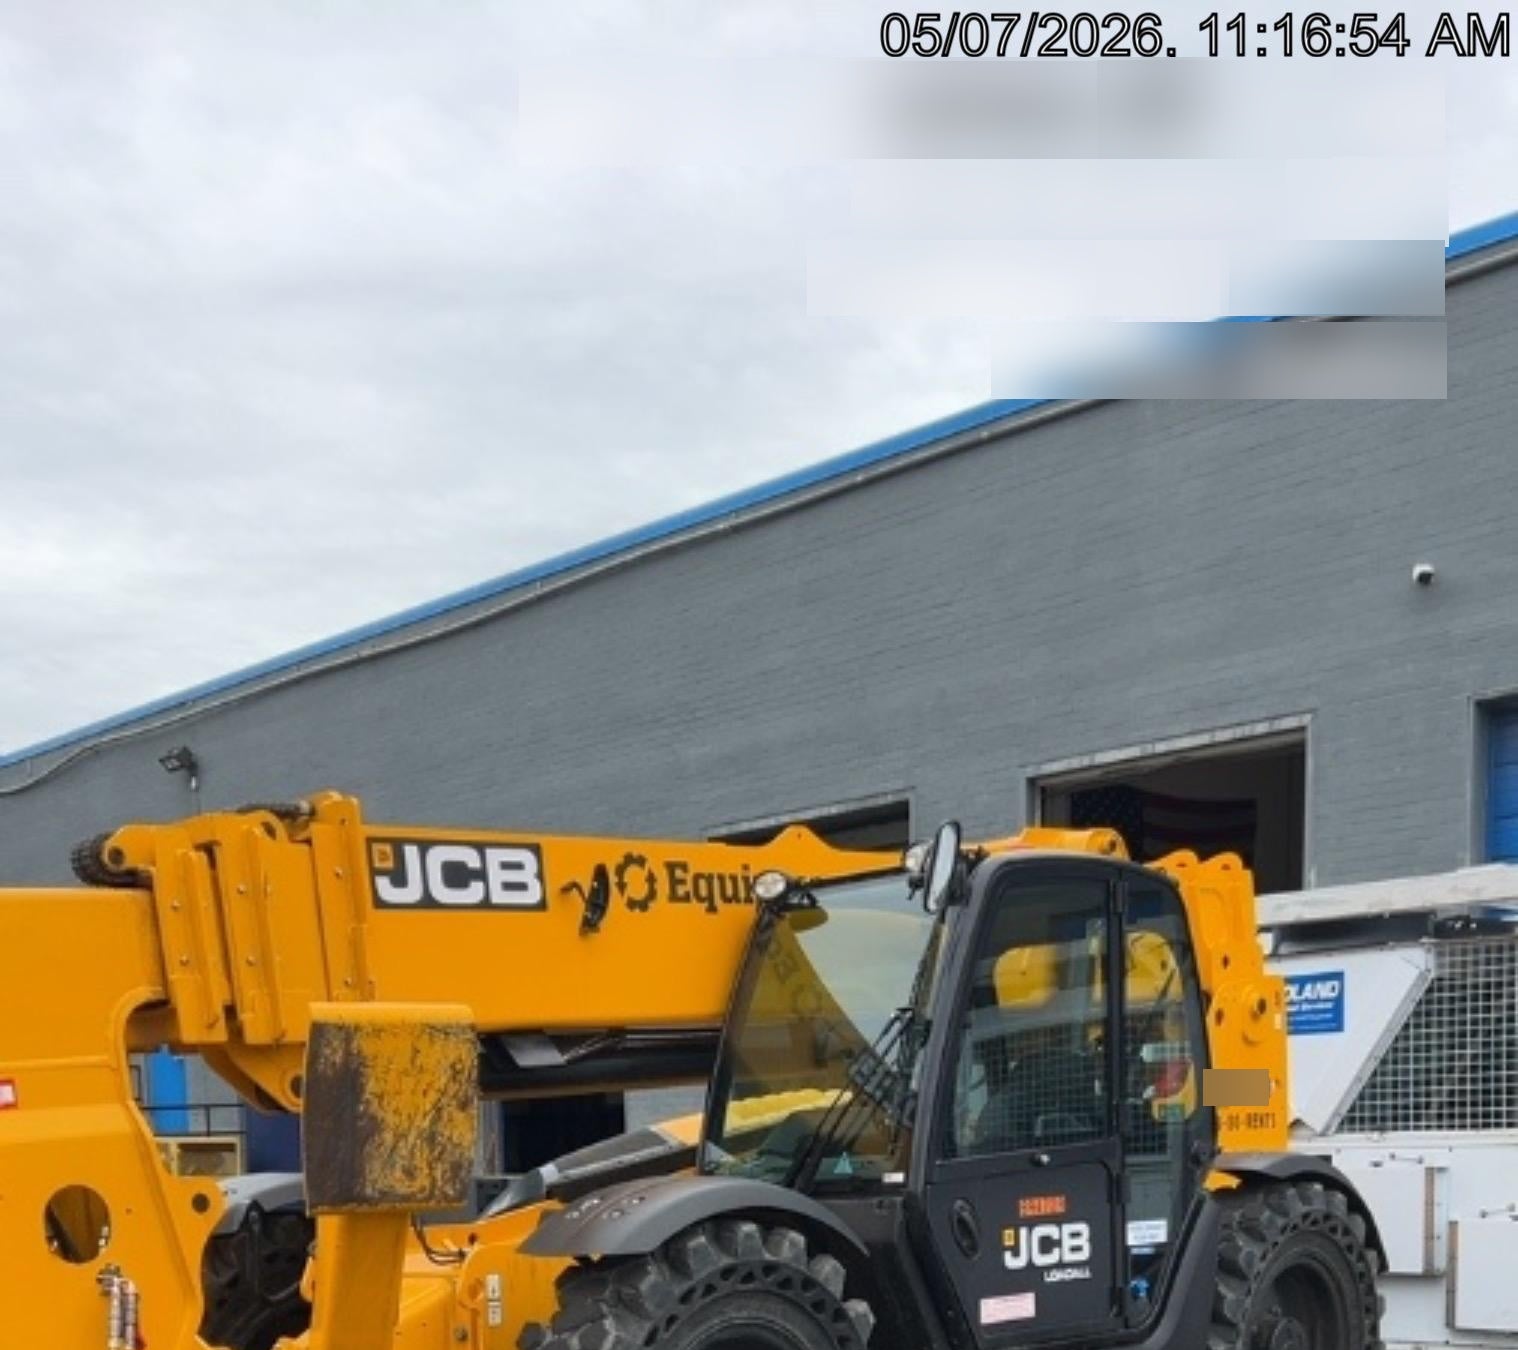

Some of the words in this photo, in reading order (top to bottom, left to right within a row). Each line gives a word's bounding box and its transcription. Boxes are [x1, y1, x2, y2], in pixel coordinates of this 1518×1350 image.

[373, 843, 543, 904] JCB
[664, 861, 757, 914] Equi
[1003, 1222, 1091, 1269] JCB
